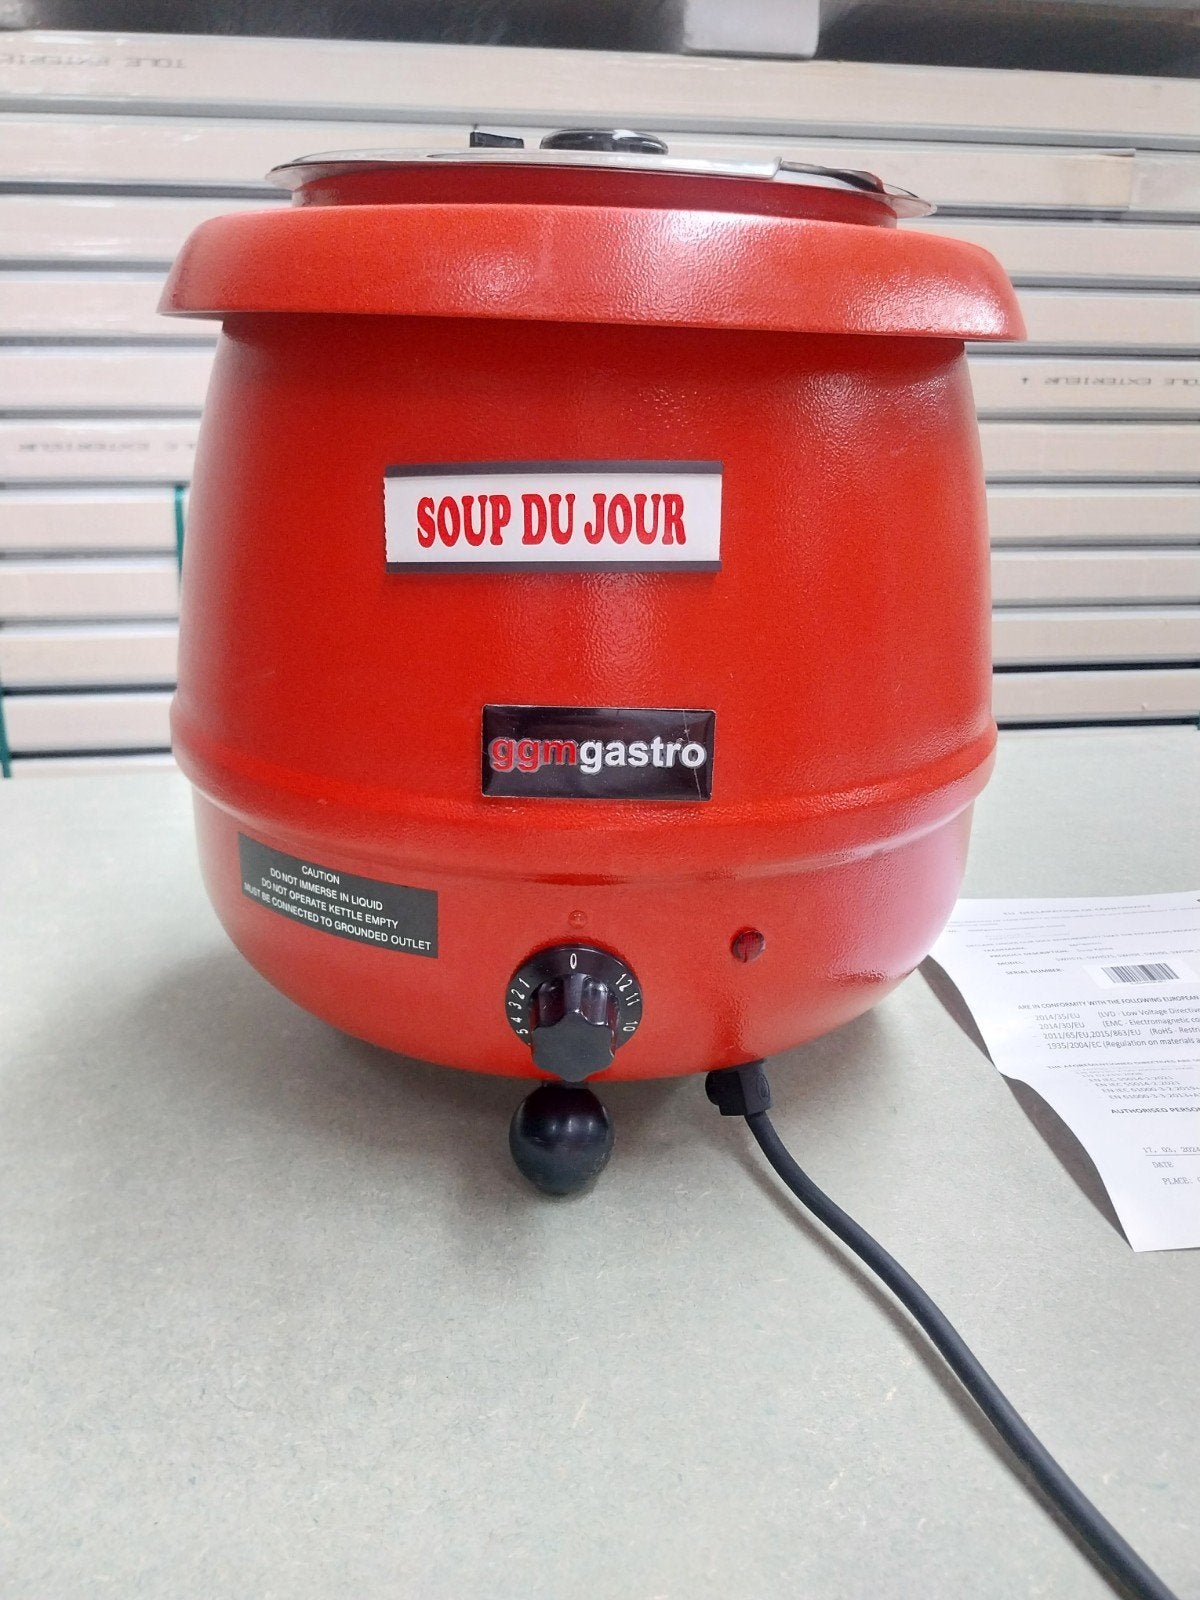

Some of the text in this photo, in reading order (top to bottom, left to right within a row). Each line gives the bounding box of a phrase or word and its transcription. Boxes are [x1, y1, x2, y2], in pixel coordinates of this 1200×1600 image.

[416, 493, 687, 548] SOUP DU JOUR
[490, 736, 706, 774] ggmgastro
[301, 865, 340, 885] CAUTION
[270, 867, 383, 911] DO NOT IMMERSE IN LIQUID
[261, 877, 399, 930] DO NOT OPERATE KETTLE EMPTY
[243, 881, 432, 951] MUST BE CONNECTED TO GROUNDED OUTLET
[569, 953, 578, 969] 0
[518, 977, 530, 988] 1
[615, 973, 633, 992] 12
[510, 988, 526, 1000] 2
[625, 992, 640, 1006] 11
[508, 1001, 522, 1010] 3
[1041, 1001, 1086, 1009] CONFORMITY
[1138, 1008, 1167, 1016] Voltage
[622, 1020, 638, 1032] 10
[1129, 1017, 1190, 1025] Electromagnetic
[1103, 1039, 1147, 1049] (Regulation
[1160, 1037, 1195, 1045] materials
